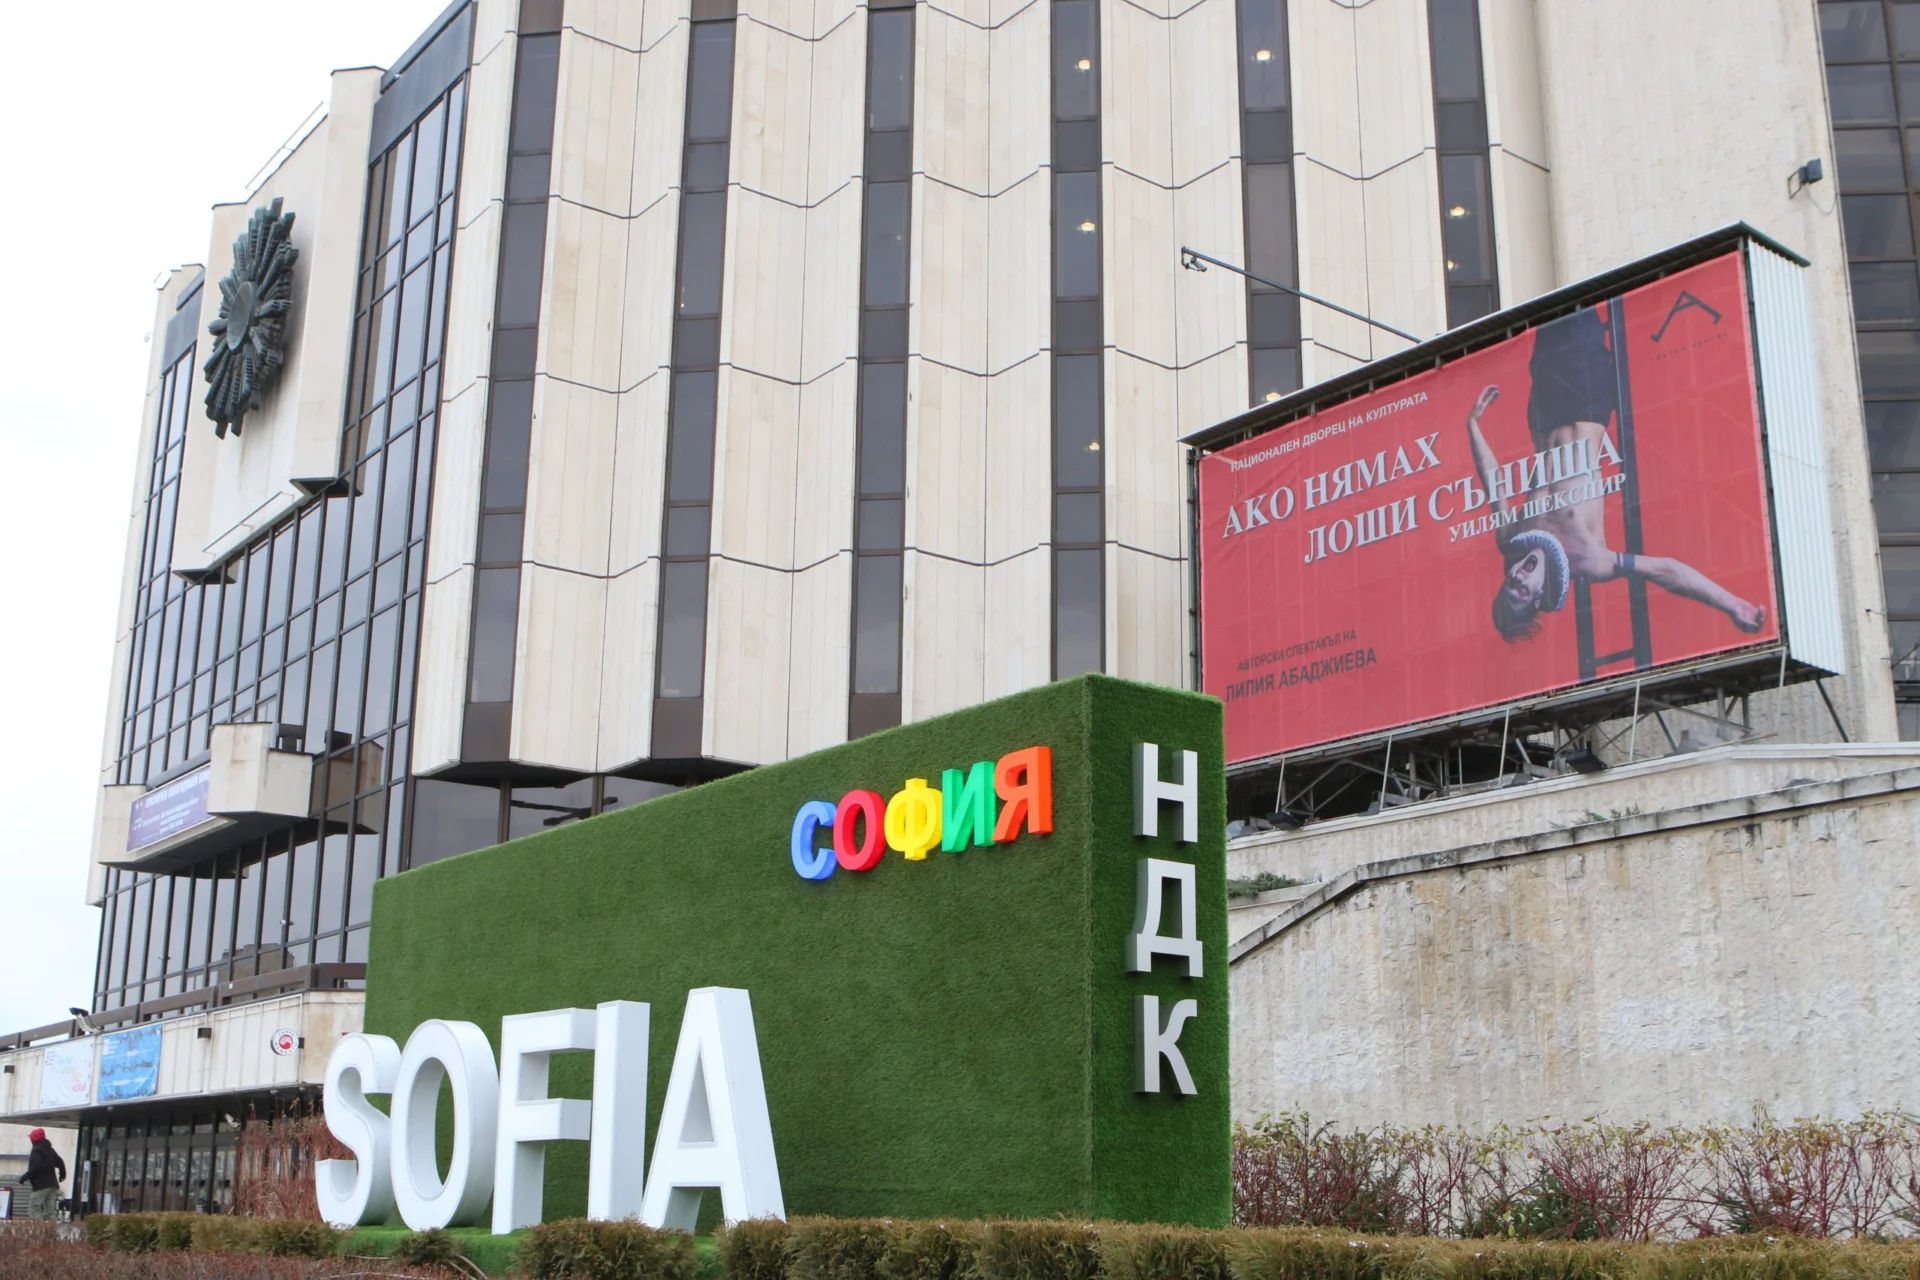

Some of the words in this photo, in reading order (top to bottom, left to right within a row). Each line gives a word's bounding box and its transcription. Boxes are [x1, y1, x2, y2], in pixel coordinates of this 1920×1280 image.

[1231, 439, 1300, 472] НАЦИОНАЛЕН
[1302, 420, 1346, 448] ДВОРЕЦ
[1348, 413, 1363, 429] НА
[1366, 391, 1428, 421] КУЛТУРАТА
[1222, 486, 1294, 539] АКО
[1303, 432, 1441, 510] НЯМАХ
[1304, 494, 1418, 563] ЛОШИ
[1428, 431, 1624, 521] СЪНИЩА
[1448, 505, 1519, 543] УИЛЯМ
[1522, 472, 1626, 520] ШЕКСПИР
[1225, 673, 1275, 703] ЛИЛИЯ
[1278, 647, 1376, 689] АБАДЖИЕВА
[1237, 650, 1284, 671] АВТОРСКИ
[1285, 633, 1341, 659] СПЕКТАКЪЛ
[1343, 629, 1357, 642] НА
[791, 745, 1053, 880] СОФИЯ
[1128, 742, 1203, 1096] НДК
[315, 986, 786, 1235] SOFIA
